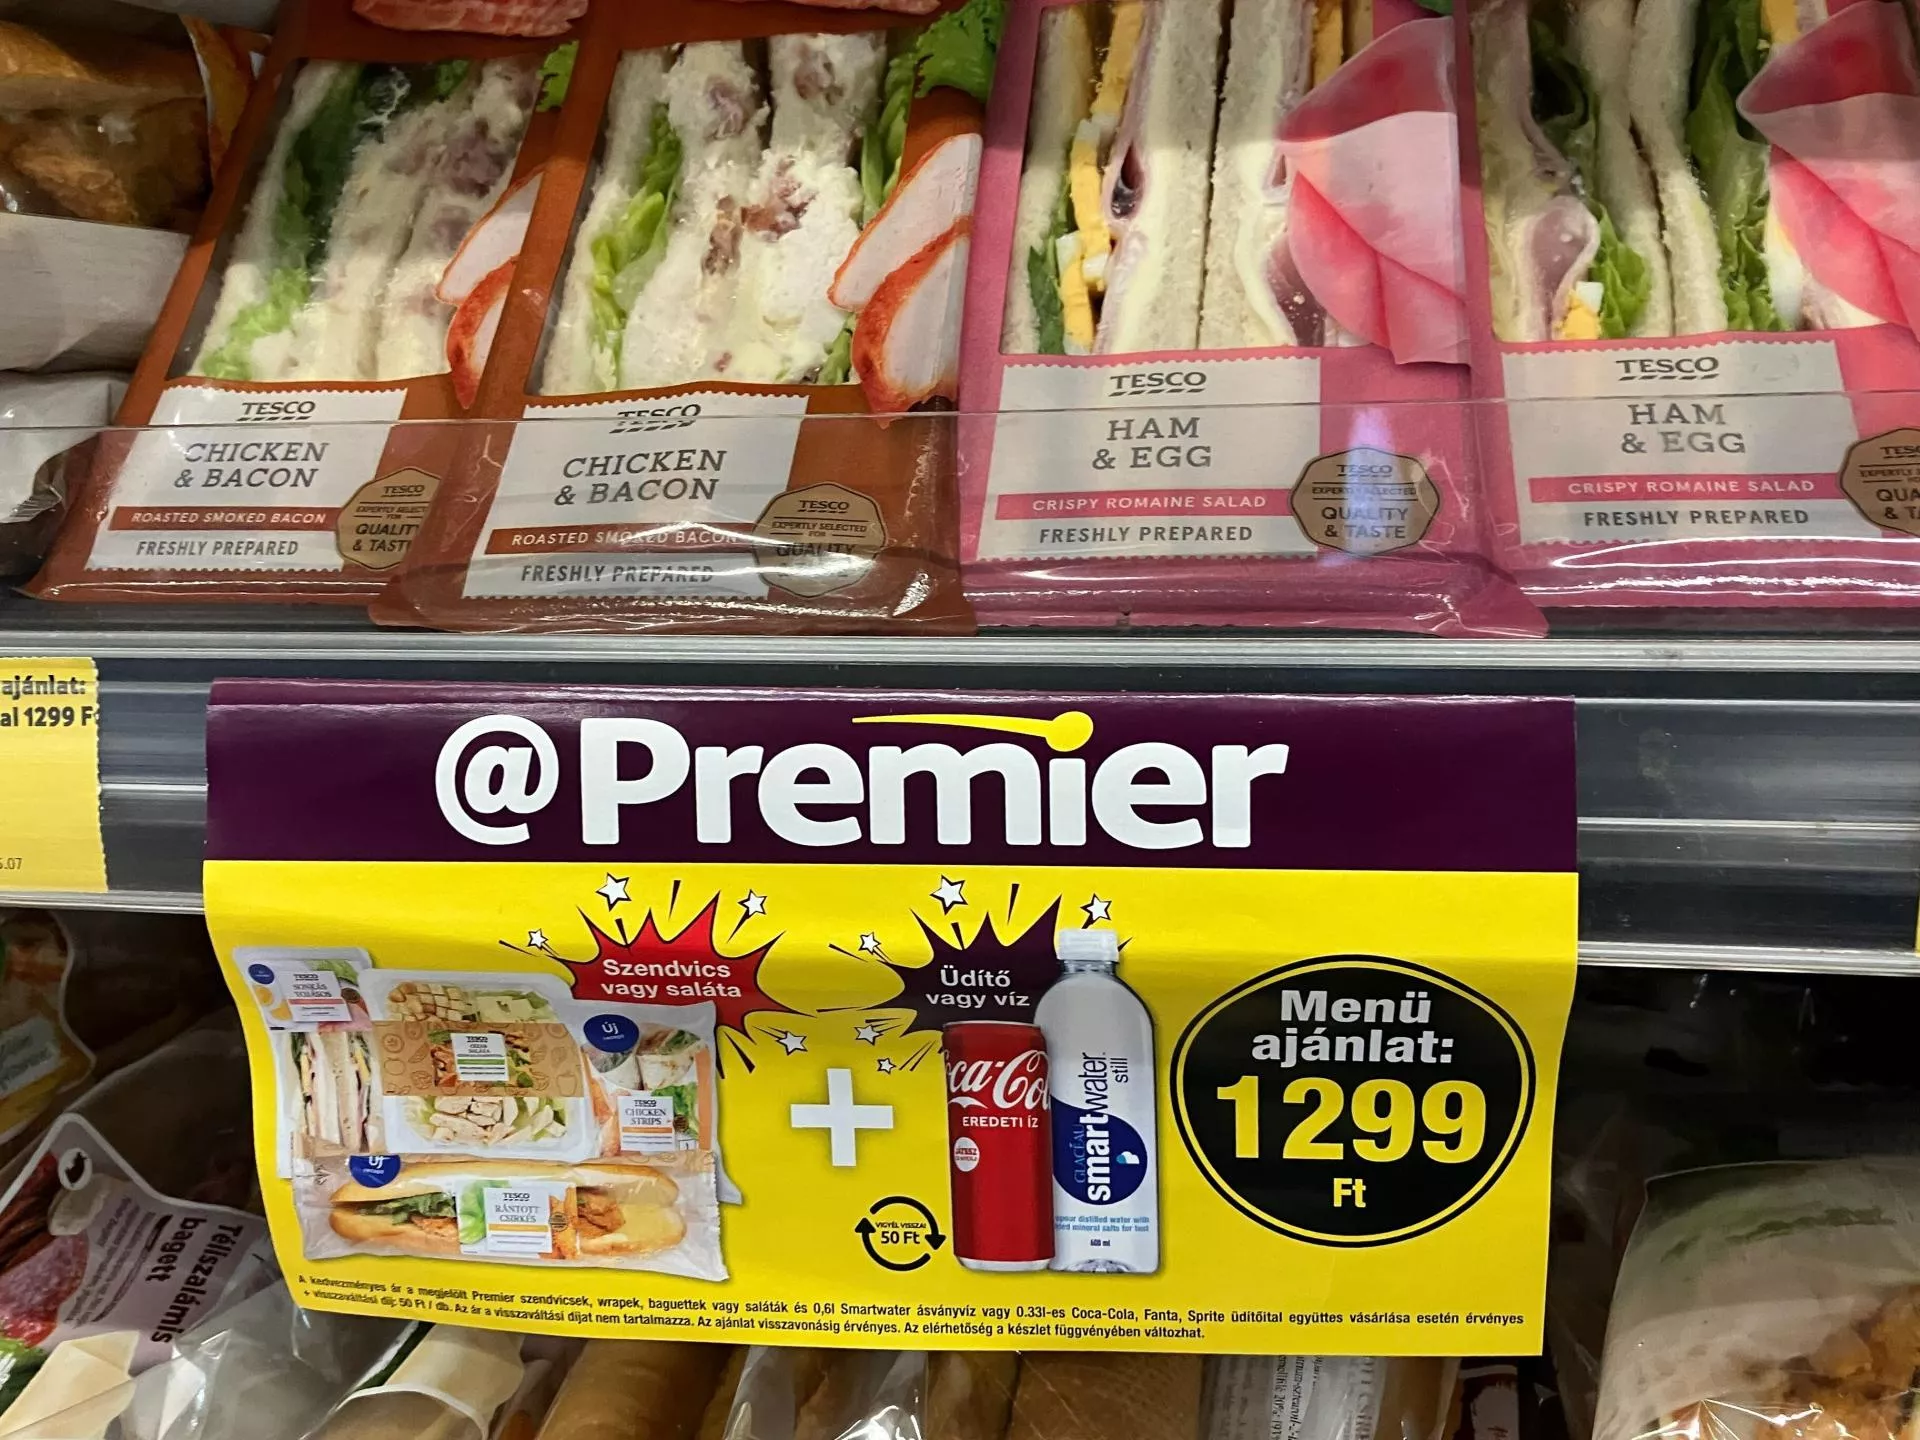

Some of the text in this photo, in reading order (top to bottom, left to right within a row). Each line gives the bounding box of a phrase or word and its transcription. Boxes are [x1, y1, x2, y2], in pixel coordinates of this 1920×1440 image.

[1616, 357, 1720, 374] TESCO
[1110, 372, 1207, 389] TESCO
[240, 401, 316, 416] TESCO
[617, 404, 702, 425] TESCO
[1628, 403, 1727, 425] HAM
[1107, 417, 1201, 441] HAM
[1621, 431, 1746, 454] & EGG
[1880, 446, 1920, 455] TES
[185, 442, 329, 463] CHICKEN
[1092, 446, 1212, 470] & EGG
[563, 449, 727, 479] CHICKEN
[1336, 464, 1393, 474] TESCO
[174, 468, 319, 488] & BACON
[384, 485, 425, 494] TESCO
[554, 478, 720, 506] & BACON
[1568, 480, 1815, 494] CRISPY ROMAINE SALAD
[799, 500, 849, 510] TESCO
[1032, 496, 1266, 512] CRISPY ROMAINE SALAD
[1885, 506, 1899, 519] &
[131, 512, 326, 524] ROASTED SMOKED BACON
[1321, 507, 1409, 520] QUALITY
[1584, 510, 1809, 527] FRESHLY PREPARED
[820, 523, 867, 533] SELECTED
[1040, 526, 1253, 544] FRESHLY PREPARED
[1325, 524, 1406, 539] & TASTE
[352, 539, 362, 551] &
[512, 533, 589, 546] ROASTED
[675, 531, 738, 544] BACON
[136, 541, 299, 556] FRESHLY PREPARED
[521, 565, 715, 583] FRESHLY PREPARED
[1, 675, 87, 700] ajánlat:
[24, 706, 75, 727] 1299
[602, 958, 731, 979] Szendvics
[940, 965, 1011, 988] Üdítő
[601, 982, 742, 999] vagy saláta
[925, 992, 1031, 1009] vagy víz
[1280, 990, 1432, 1024] Menü
[602, 1022, 619, 1035] Új
[1251, 1027, 1454, 1067] ajánlat:
[1109, 1057, 1129, 1083] still
[625, 1108, 667, 1116] CHICKEN
[1216, 1075, 1487, 1164] 1299
[631, 1117, 662, 1126] STRIPS
[962, 1115, 1039, 1128] EREDETI ÍZ
[503, 1192, 530, 1200] TESCO
[1332, 1177, 1367, 1208] Ft
[495, 1204, 541, 1213] RÁNTOTT
[881, 1231, 921, 1244] 50 Ft
[145, 1217, 207, 1283] bagett
[151, 1224, 243, 1344] Téliszalámis
[390, 1283, 401, 1293] ár
[418, 1287, 468, 1300] megjelölt
[472, 1291, 515, 1303] Premier
[520, 1294, 593, 1308] szendvicsek,
[597, 1298, 644, 1310] wrapek,
[648, 1298, 707, 1311] baguettek
[712, 1302, 739, 1313] vagy
[745, 1301, 788, 1313] saláták
[794, 1302, 808, 1314] és
[813, 1302, 835, 1316] 0,6l
[841, 1302, 911, 1316] Smartwater
[917, 1305, 976, 1319] ásványvíz
[982, 1307, 1011, 1319] vagy
[1016, 1306, 1066, 1318] 0.33l-es
[1071, 1307, 1139, 1322] Coca-Cola,
[1144, 1308, 1182, 1323] Fanta,
[1188, 1310, 1225, 1324] Sprite
[1231, 1311, 1283, 1323] üdítőital
[1289, 1312, 1343, 1325] együttes
[1350, 1312, 1410, 1324] vásárlása
[1416, 1312, 1459, 1324] esetén
[1465, 1312, 1524, 1326] érvényes
[399, 1298, 413, 1307] 50
[415, 1299, 426, 1309] Ft
[455, 1303, 469, 1314] Az
[471, 1304, 481, 1315] ár
[485, 1308, 492, 1316] a
[494, 1307, 565, 1321] visszaváltási
[568, 1312, 593, 1324] díjat
[596, 1314, 620, 1324] nem
[624, 1314, 695, 1326] tartalmazza.
[697, 1316, 712, 1327] Az
[715, 1317, 755, 1329] ajánlat
[758, 1318, 840, 1334] visszavonásig
[844, 1320, 901, 1335] érvényes.
[904, 1322, 919, 1333] Az
[922, 1322, 993, 1336] elérhetőség
[997, 1326, 1004, 1334] a
[1008, 1324, 1052, 1336] készlet
[1054, 1324, 1141, 1338] függvényében
[1145, 1325, 1206, 1338] változhat.
